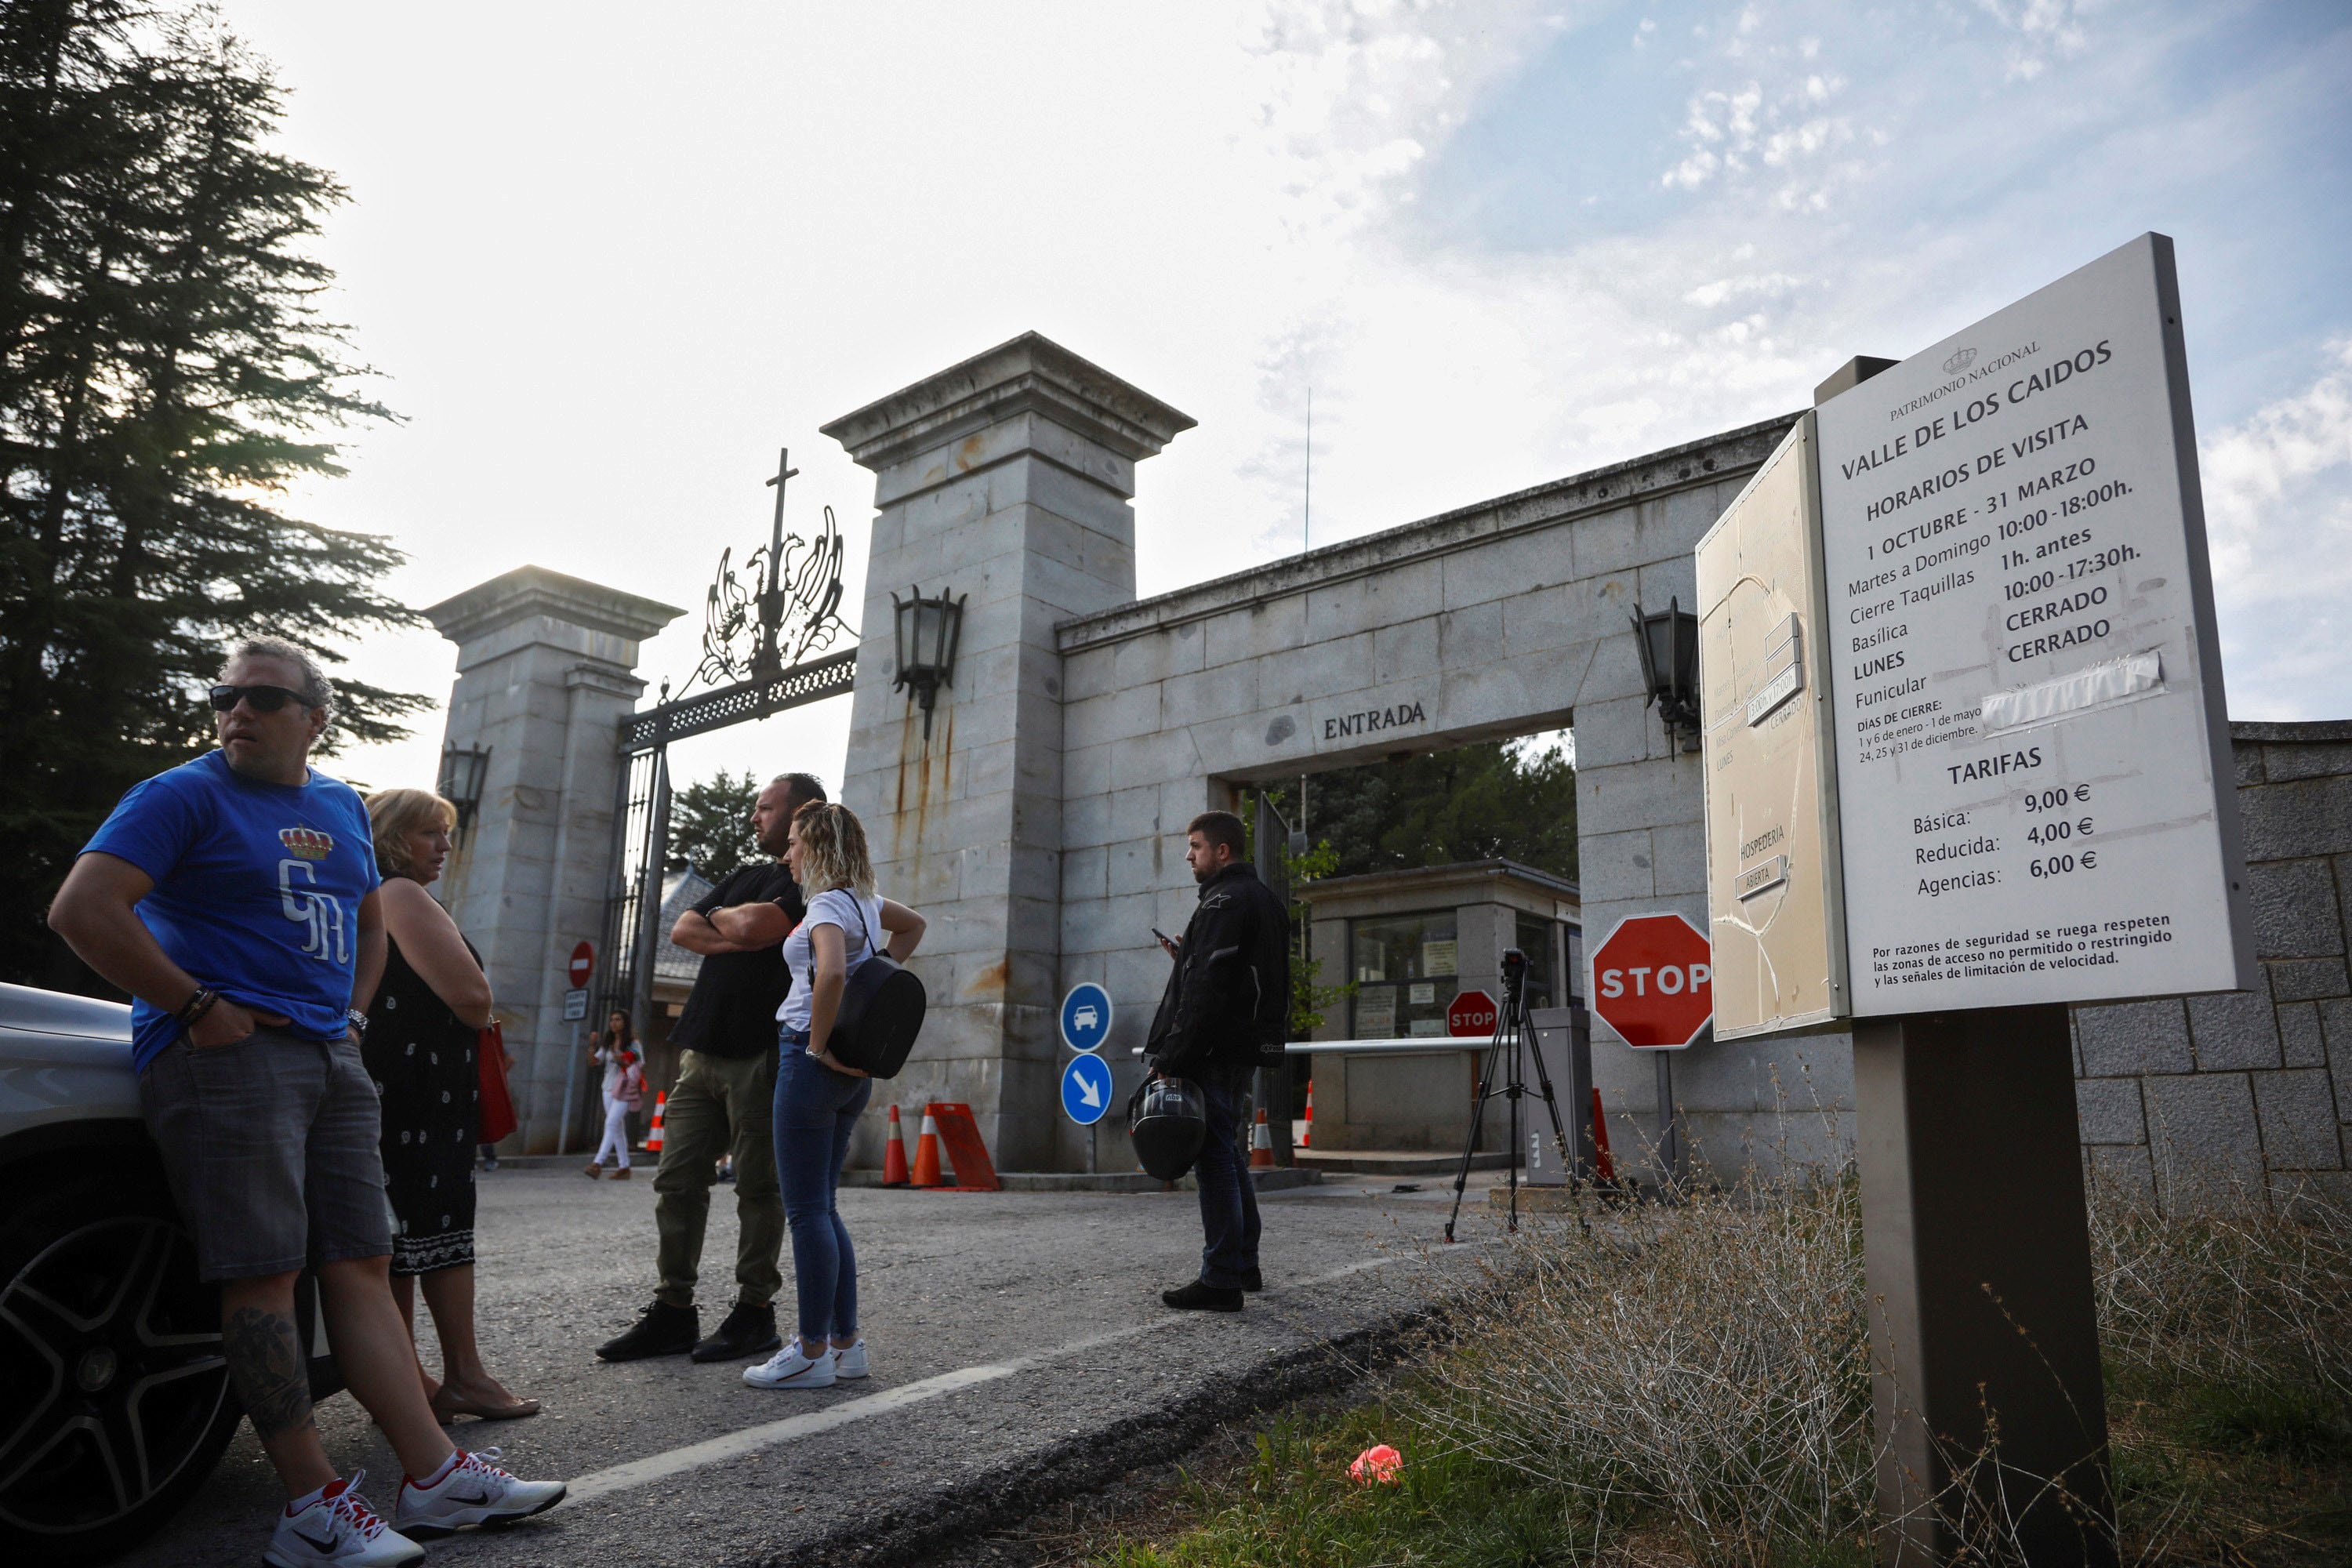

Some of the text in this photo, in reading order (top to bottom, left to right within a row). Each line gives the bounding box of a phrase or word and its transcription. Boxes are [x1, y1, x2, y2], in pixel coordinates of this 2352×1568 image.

[1889, 341, 2040, 422] PATRIMONIO NACIONAL
[1842, 339, 2111, 480] VALLE DE LOS CAIDOS
[1867, 414, 2089, 521] HORARIOS DE VISITA
[1867, 546, 1873, 560] 1
[1882, 507, 1967, 554] OCTUBRE
[1987, 492, 2006, 514] 31
[2018, 457, 2095, 501] MARZO
[1849, 569, 1896, 597] Martes
[1902, 564, 1911, 577] a
[1915, 534, 1990, 572] Domingo
[1850, 599, 1894, 624] Cierre
[1899, 570, 1974, 605] Taquillas
[2036, 528, 2092, 558] antes
[1852, 624, 1907, 652] Basílica
[1854, 586, 2107, 681] LUNES CERRADO
[1856, 619, 2110, 709] Funicular CERRADO
[1773, 673, 1795, 699] 17:00h.
[1324, 701, 1426, 739] ENTRADA
[1716, 697, 1802, 772] LUNES CERRADO
[1857, 700, 1941, 732] DÍAS DE CIERRE:
[1859, 738, 1862, 747] 1
[1866, 737, 1871, 747] y
[1874, 732, 1880, 743] 6
[1882, 730, 1893, 741] de
[1896, 724, 1922, 737] enero
[1931, 717, 1935, 728] 1
[1938, 714, 1951, 726] de
[1954, 708, 1981, 721] mayo
[1860, 726, 1977, 763] 24, 25 y 31 de diciembre.
[1947, 746, 2042, 784] TARIFAS
[1914, 783, 2090, 834] Básica: 9,00 €
[1740, 823, 1784, 861] HOSPEDERÍA
[1915, 817, 2093, 864] Reducida: 4,00 €
[1745, 867, 1770, 890] ABIERTA
[1918, 851, 2097, 897] Agencias: 6,00 €
[1873, 915, 2169, 958] Por razones de seguridad se ruega respeten
[1874, 929, 2172, 971] las zonas de acceso no permitido o restringido
[1600, 963, 1711, 999] STOP
[1874, 951, 2118, 988] y las señales de limitación de velocidad.
[1451, 1011, 1494, 1028] STOP
